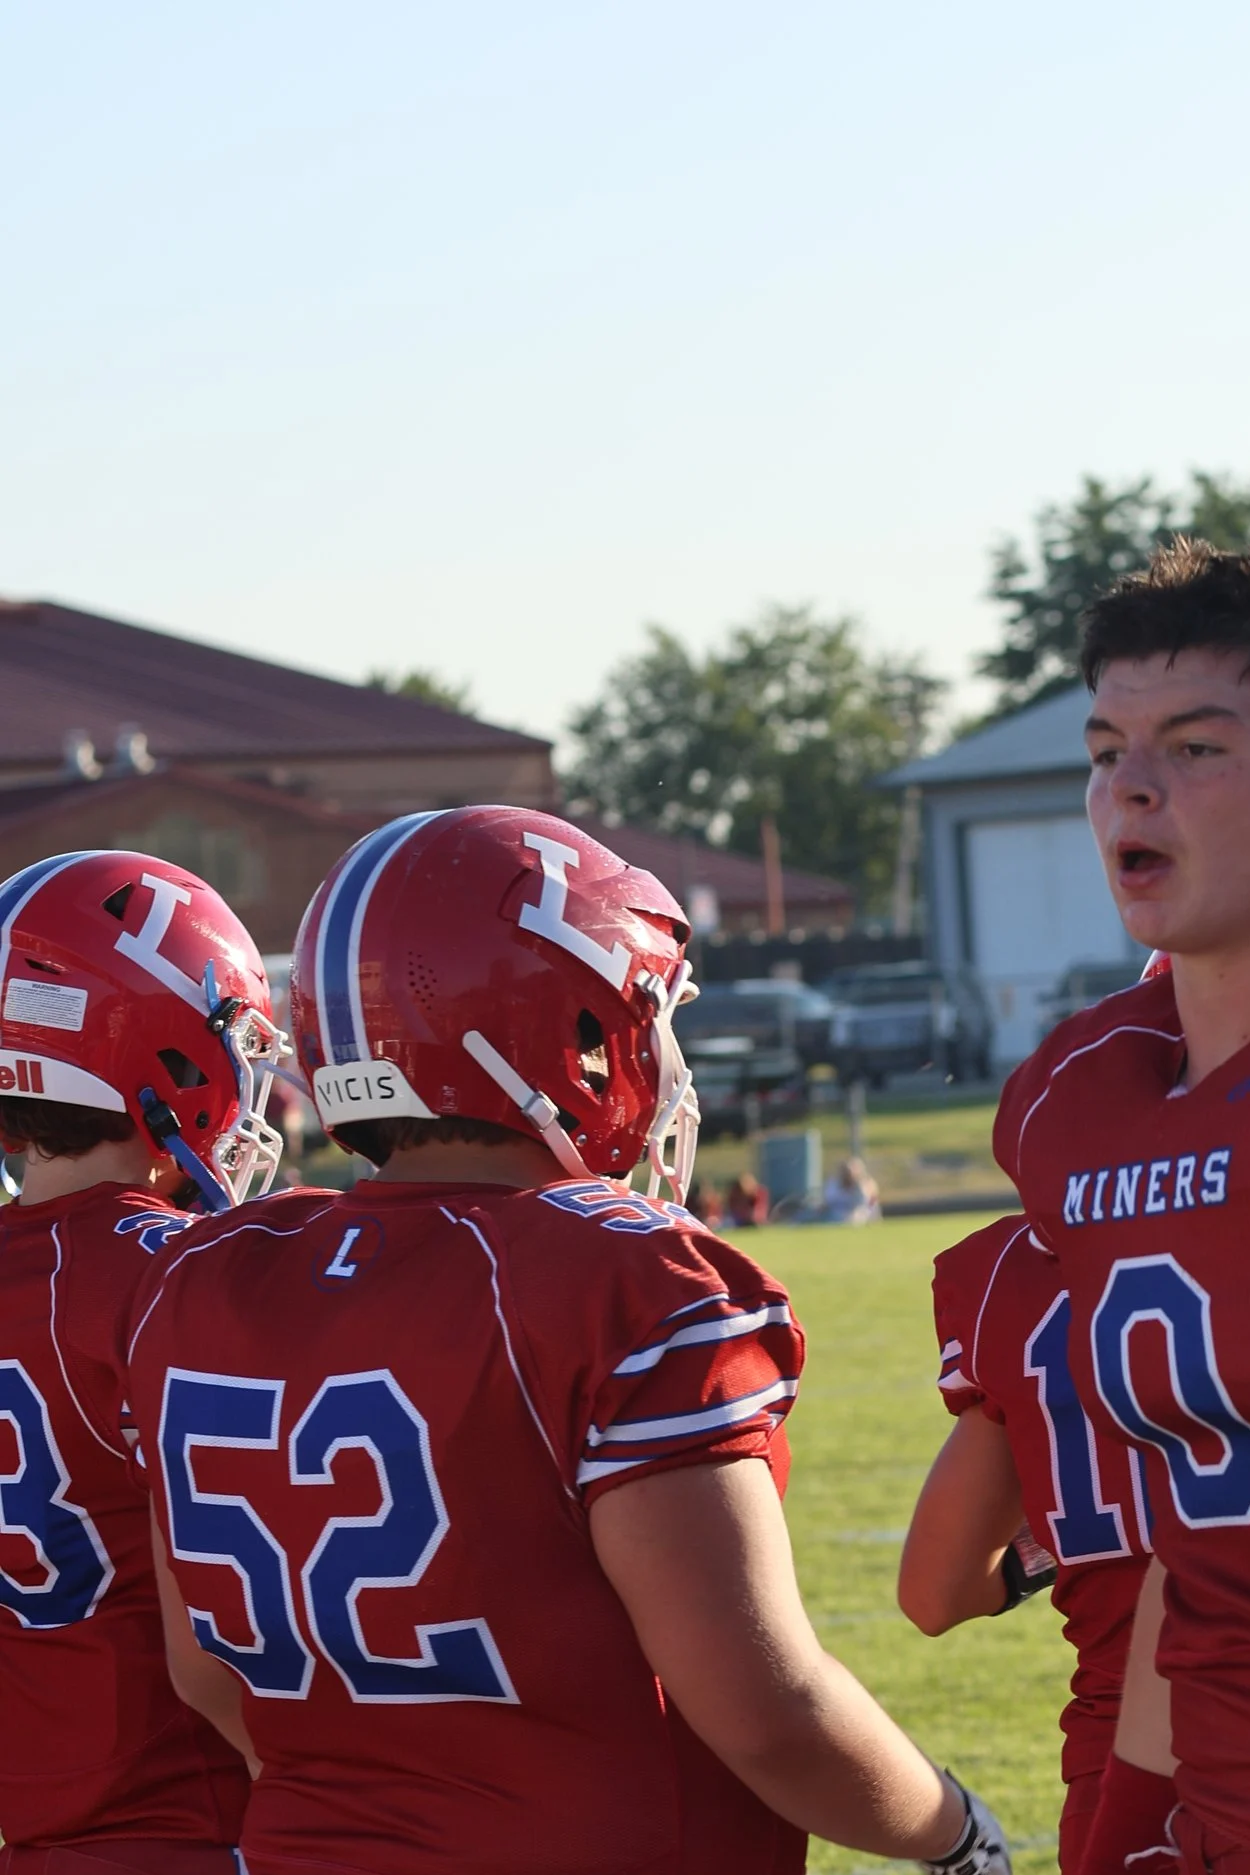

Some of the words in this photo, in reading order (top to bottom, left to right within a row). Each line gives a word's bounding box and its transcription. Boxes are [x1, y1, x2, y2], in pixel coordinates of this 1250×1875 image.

[114, 873, 221, 1018] L
[518, 832, 632, 991] L
[317, 1076, 394, 1107] VICIS
[1062, 1147, 1231, 1225] MINERS
[157, 1367, 521, 1705] 52
